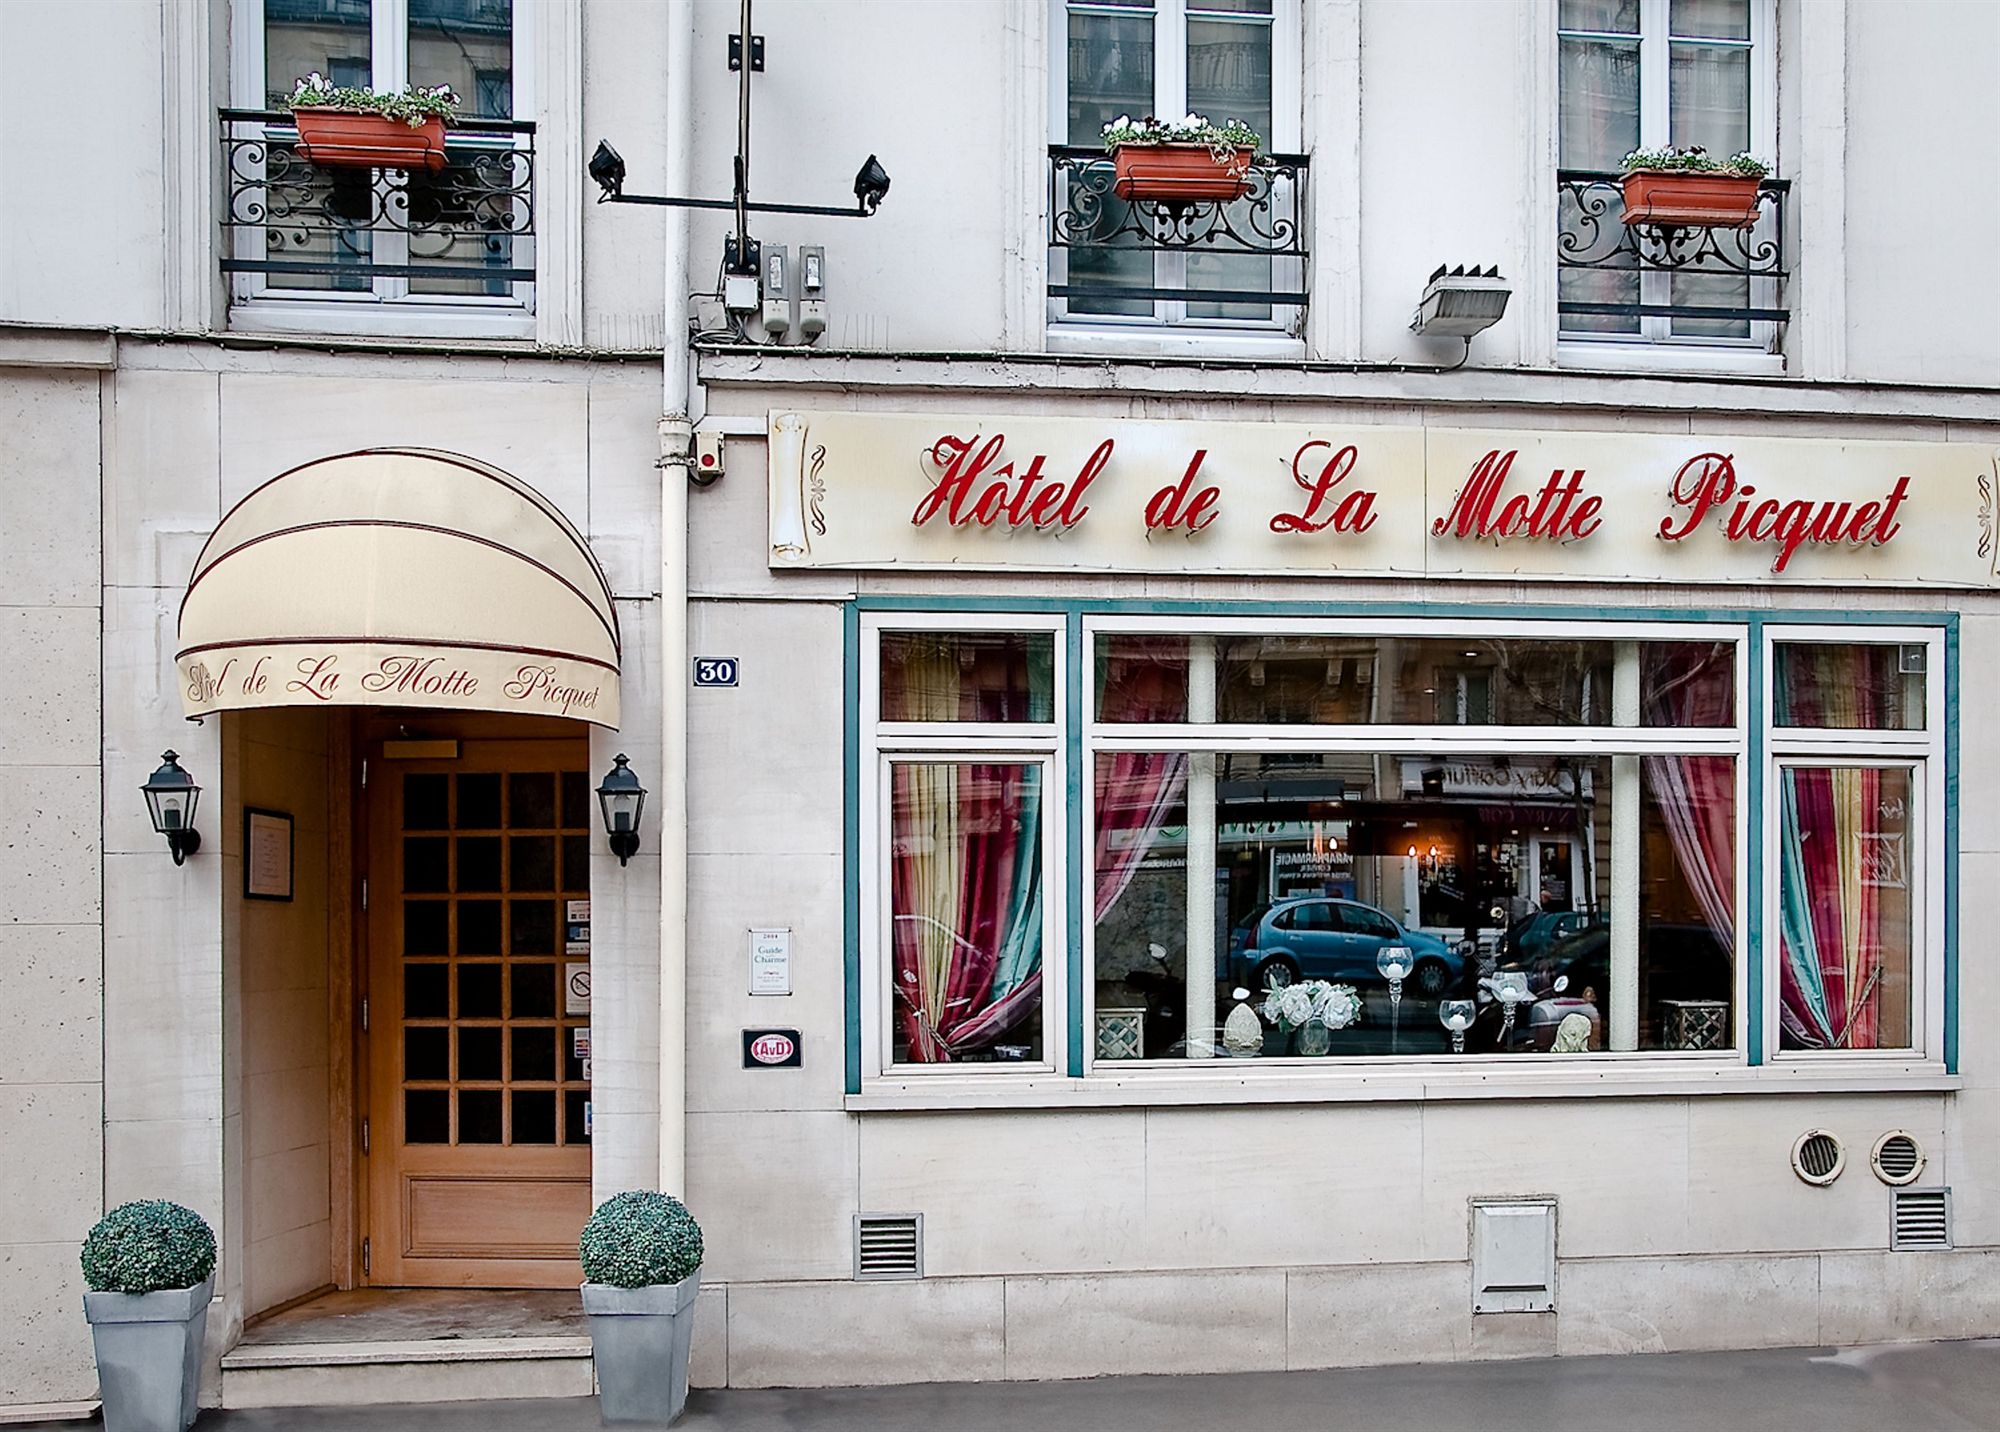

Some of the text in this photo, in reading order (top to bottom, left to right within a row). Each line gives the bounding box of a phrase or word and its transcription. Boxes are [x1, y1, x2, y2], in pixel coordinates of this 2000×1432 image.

[911, 433, 1911, 574] Hôtel de La Motte Picquet
[242, 656, 272, 695] de
[286, 655, 339, 700] La
[361, 656, 480, 697] Motte
[503, 665, 600, 715] Picquet
[700, 661, 732, 682] 30
[760, 1041, 785, 1056] AvD
